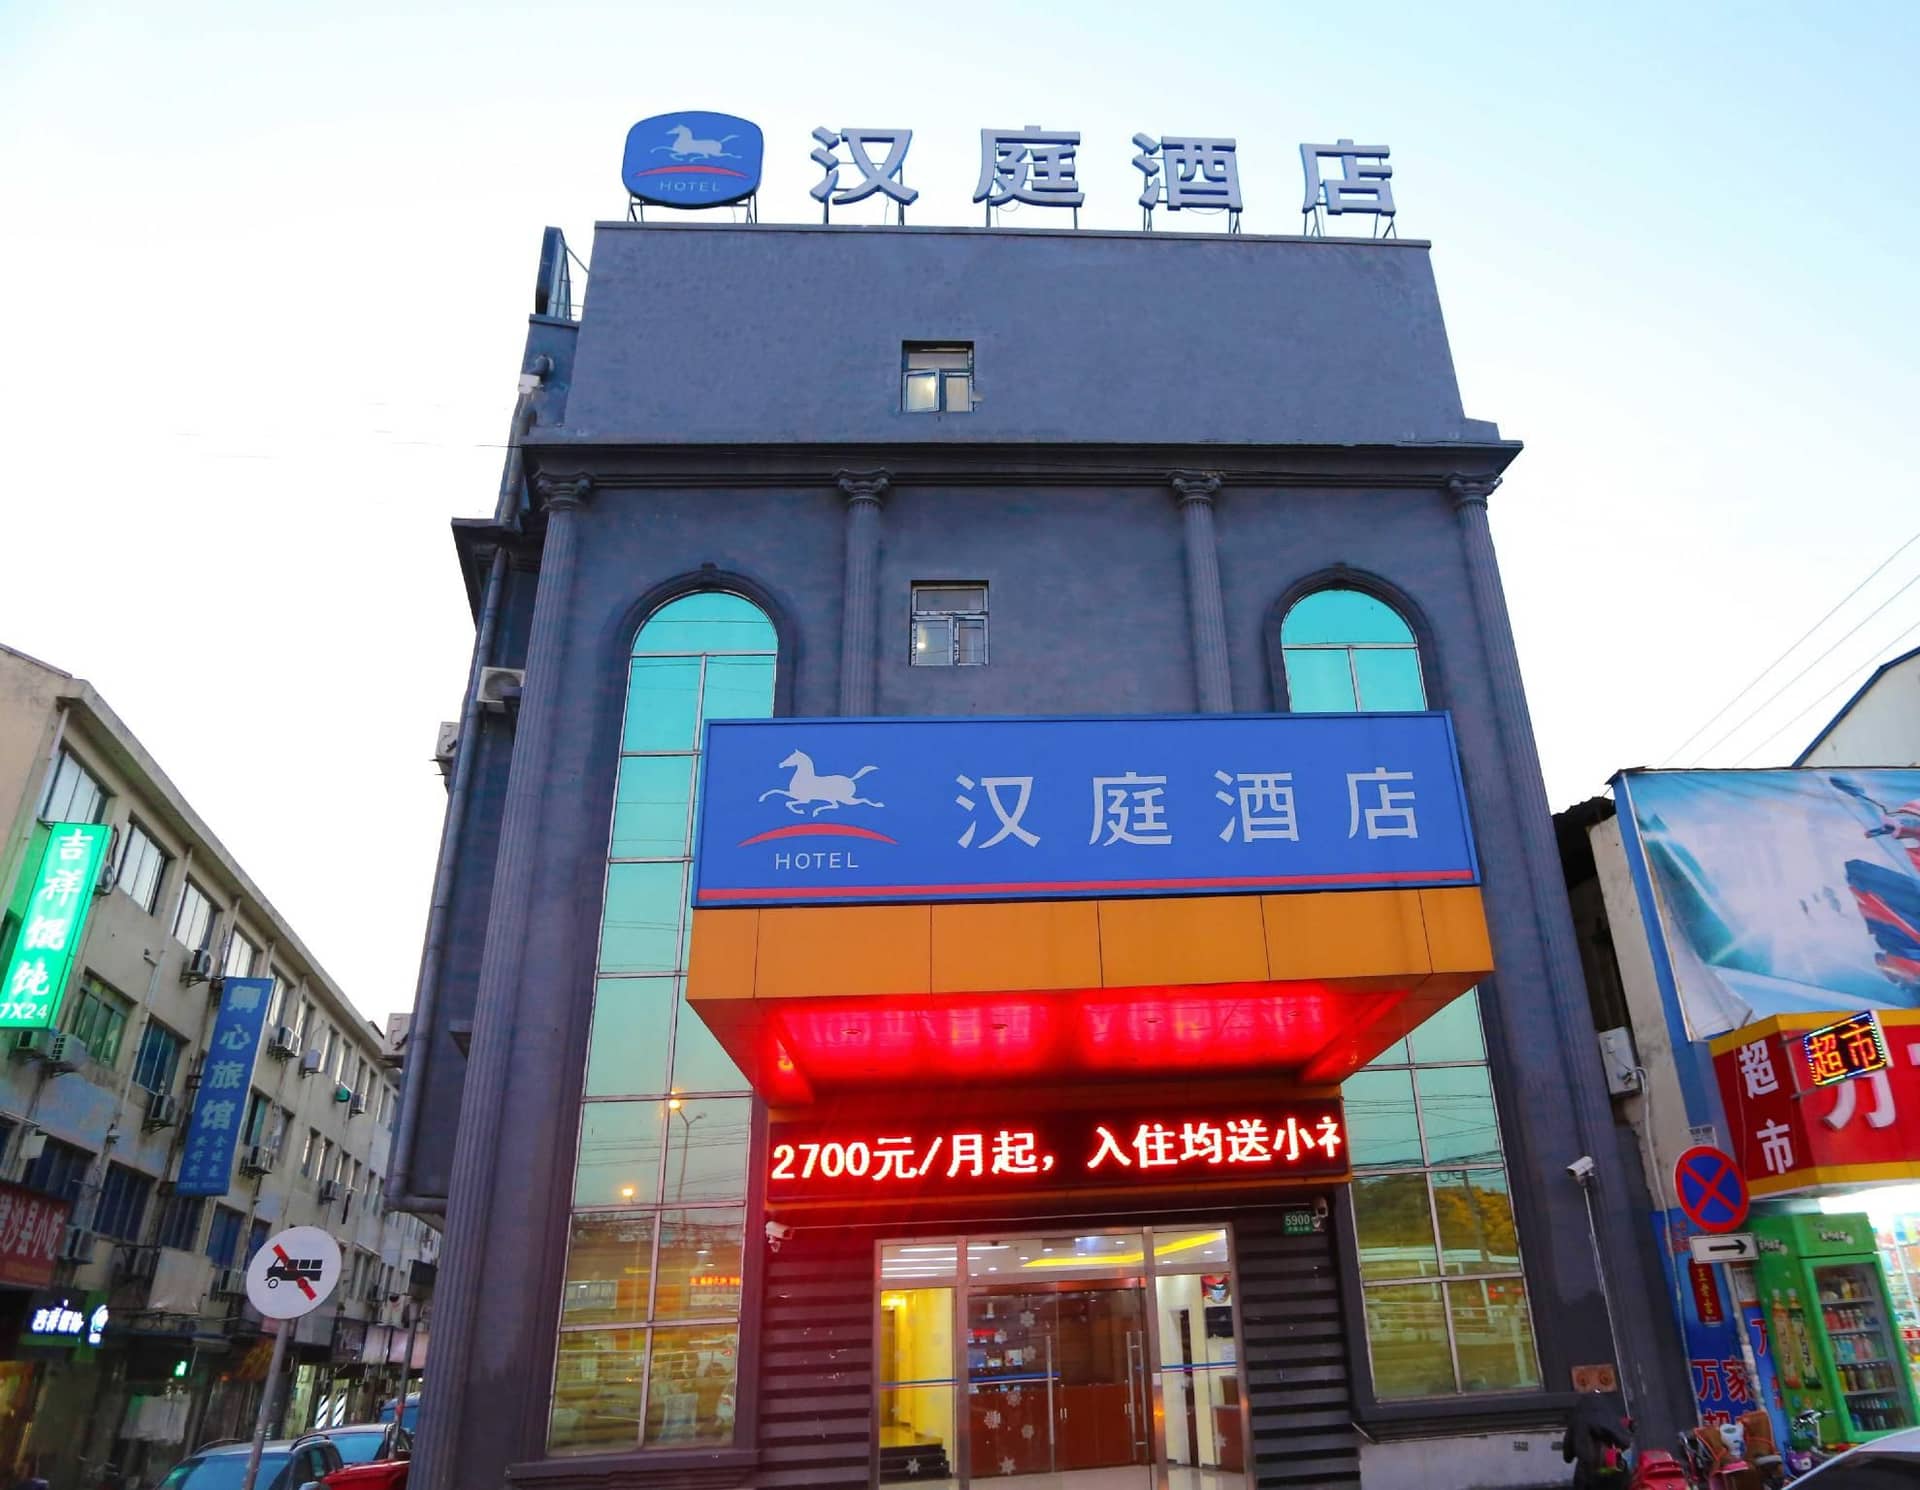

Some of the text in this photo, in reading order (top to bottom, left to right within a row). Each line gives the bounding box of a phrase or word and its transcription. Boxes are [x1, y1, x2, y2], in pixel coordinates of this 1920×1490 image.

[659, 180, 720, 193] HOTEL
[809, 126, 1396, 216] 汉庭酒店
[955, 767, 1419, 849] 汉庭酒店
[775, 851, 859, 870] HOTEL
[13, 828, 94, 996] 吉祥馄饨
[1809, 1023, 1876, 1082] 超市
[1738, 1038, 1795, 1175] 超市
[1285, 1214, 1310, 1226] 5900
